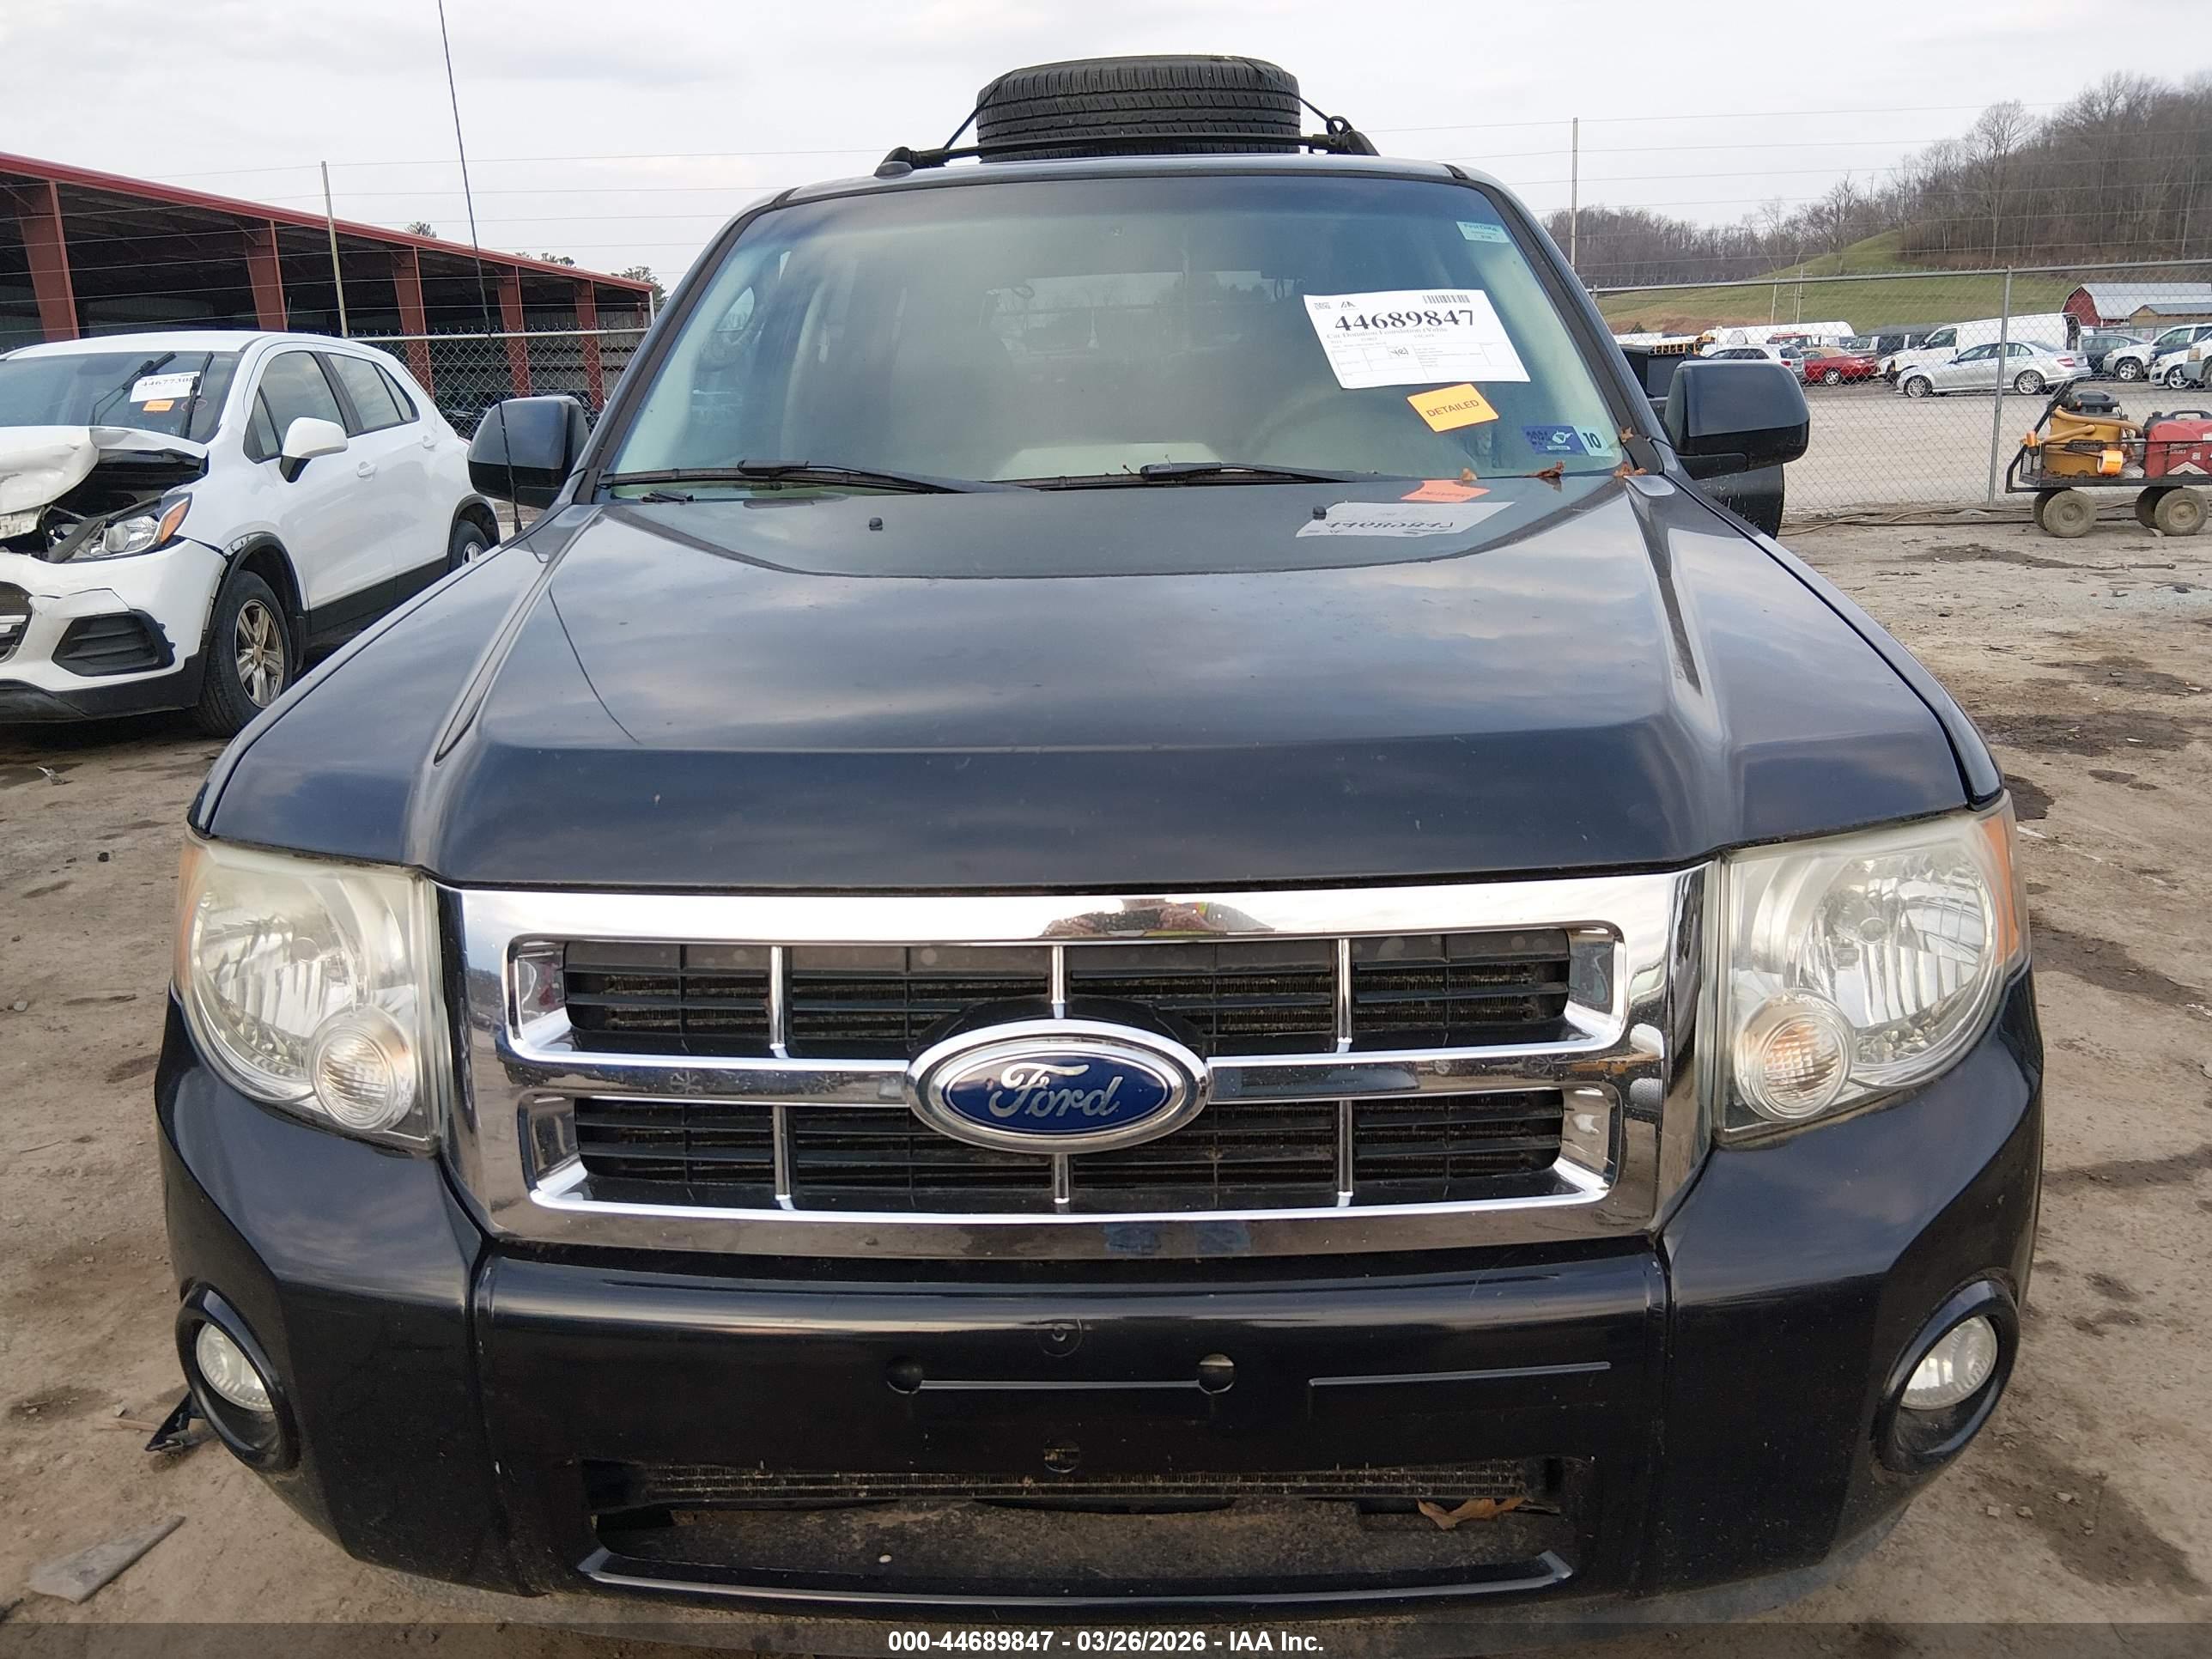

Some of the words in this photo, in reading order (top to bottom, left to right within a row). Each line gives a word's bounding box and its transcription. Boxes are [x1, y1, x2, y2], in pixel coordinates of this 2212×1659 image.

[1335, 310, 1473, 331] 44689847
[1425, 399, 1480, 417] DETAILED
[1582, 432, 1602, 449] 10
[989, 1062, 1123, 1117] Ford
